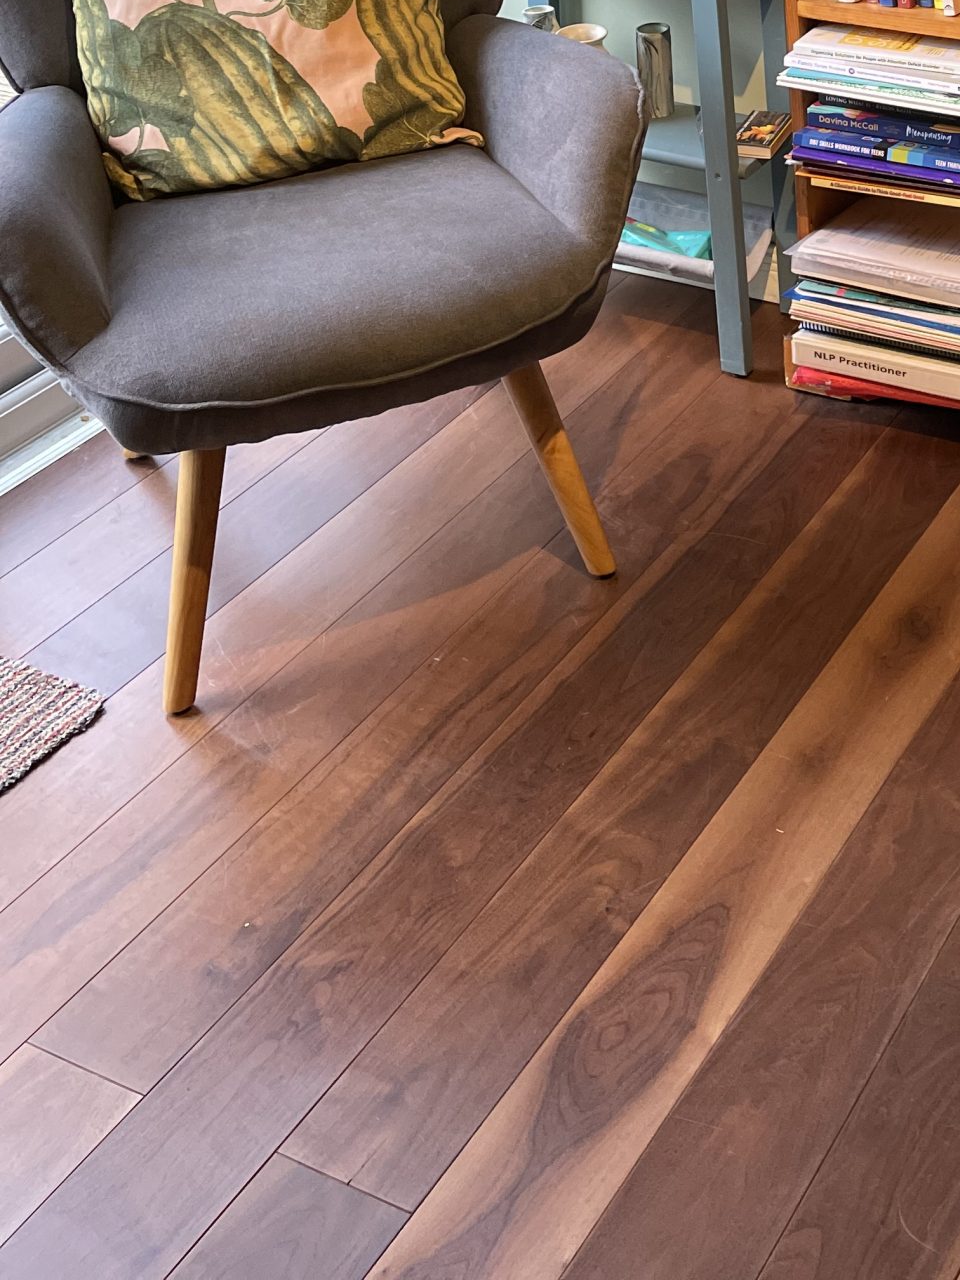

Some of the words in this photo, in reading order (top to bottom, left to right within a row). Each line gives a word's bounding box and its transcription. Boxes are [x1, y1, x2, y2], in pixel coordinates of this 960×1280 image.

[825, 95, 847, 103] LOVING
[817, 115, 848, 127] Davina
[849, 120, 879, 131] McCall
[905, 125, 952, 144] Menopausing
[813, 350, 836, 362] NLP
[838, 355, 908, 378] Practitioner
